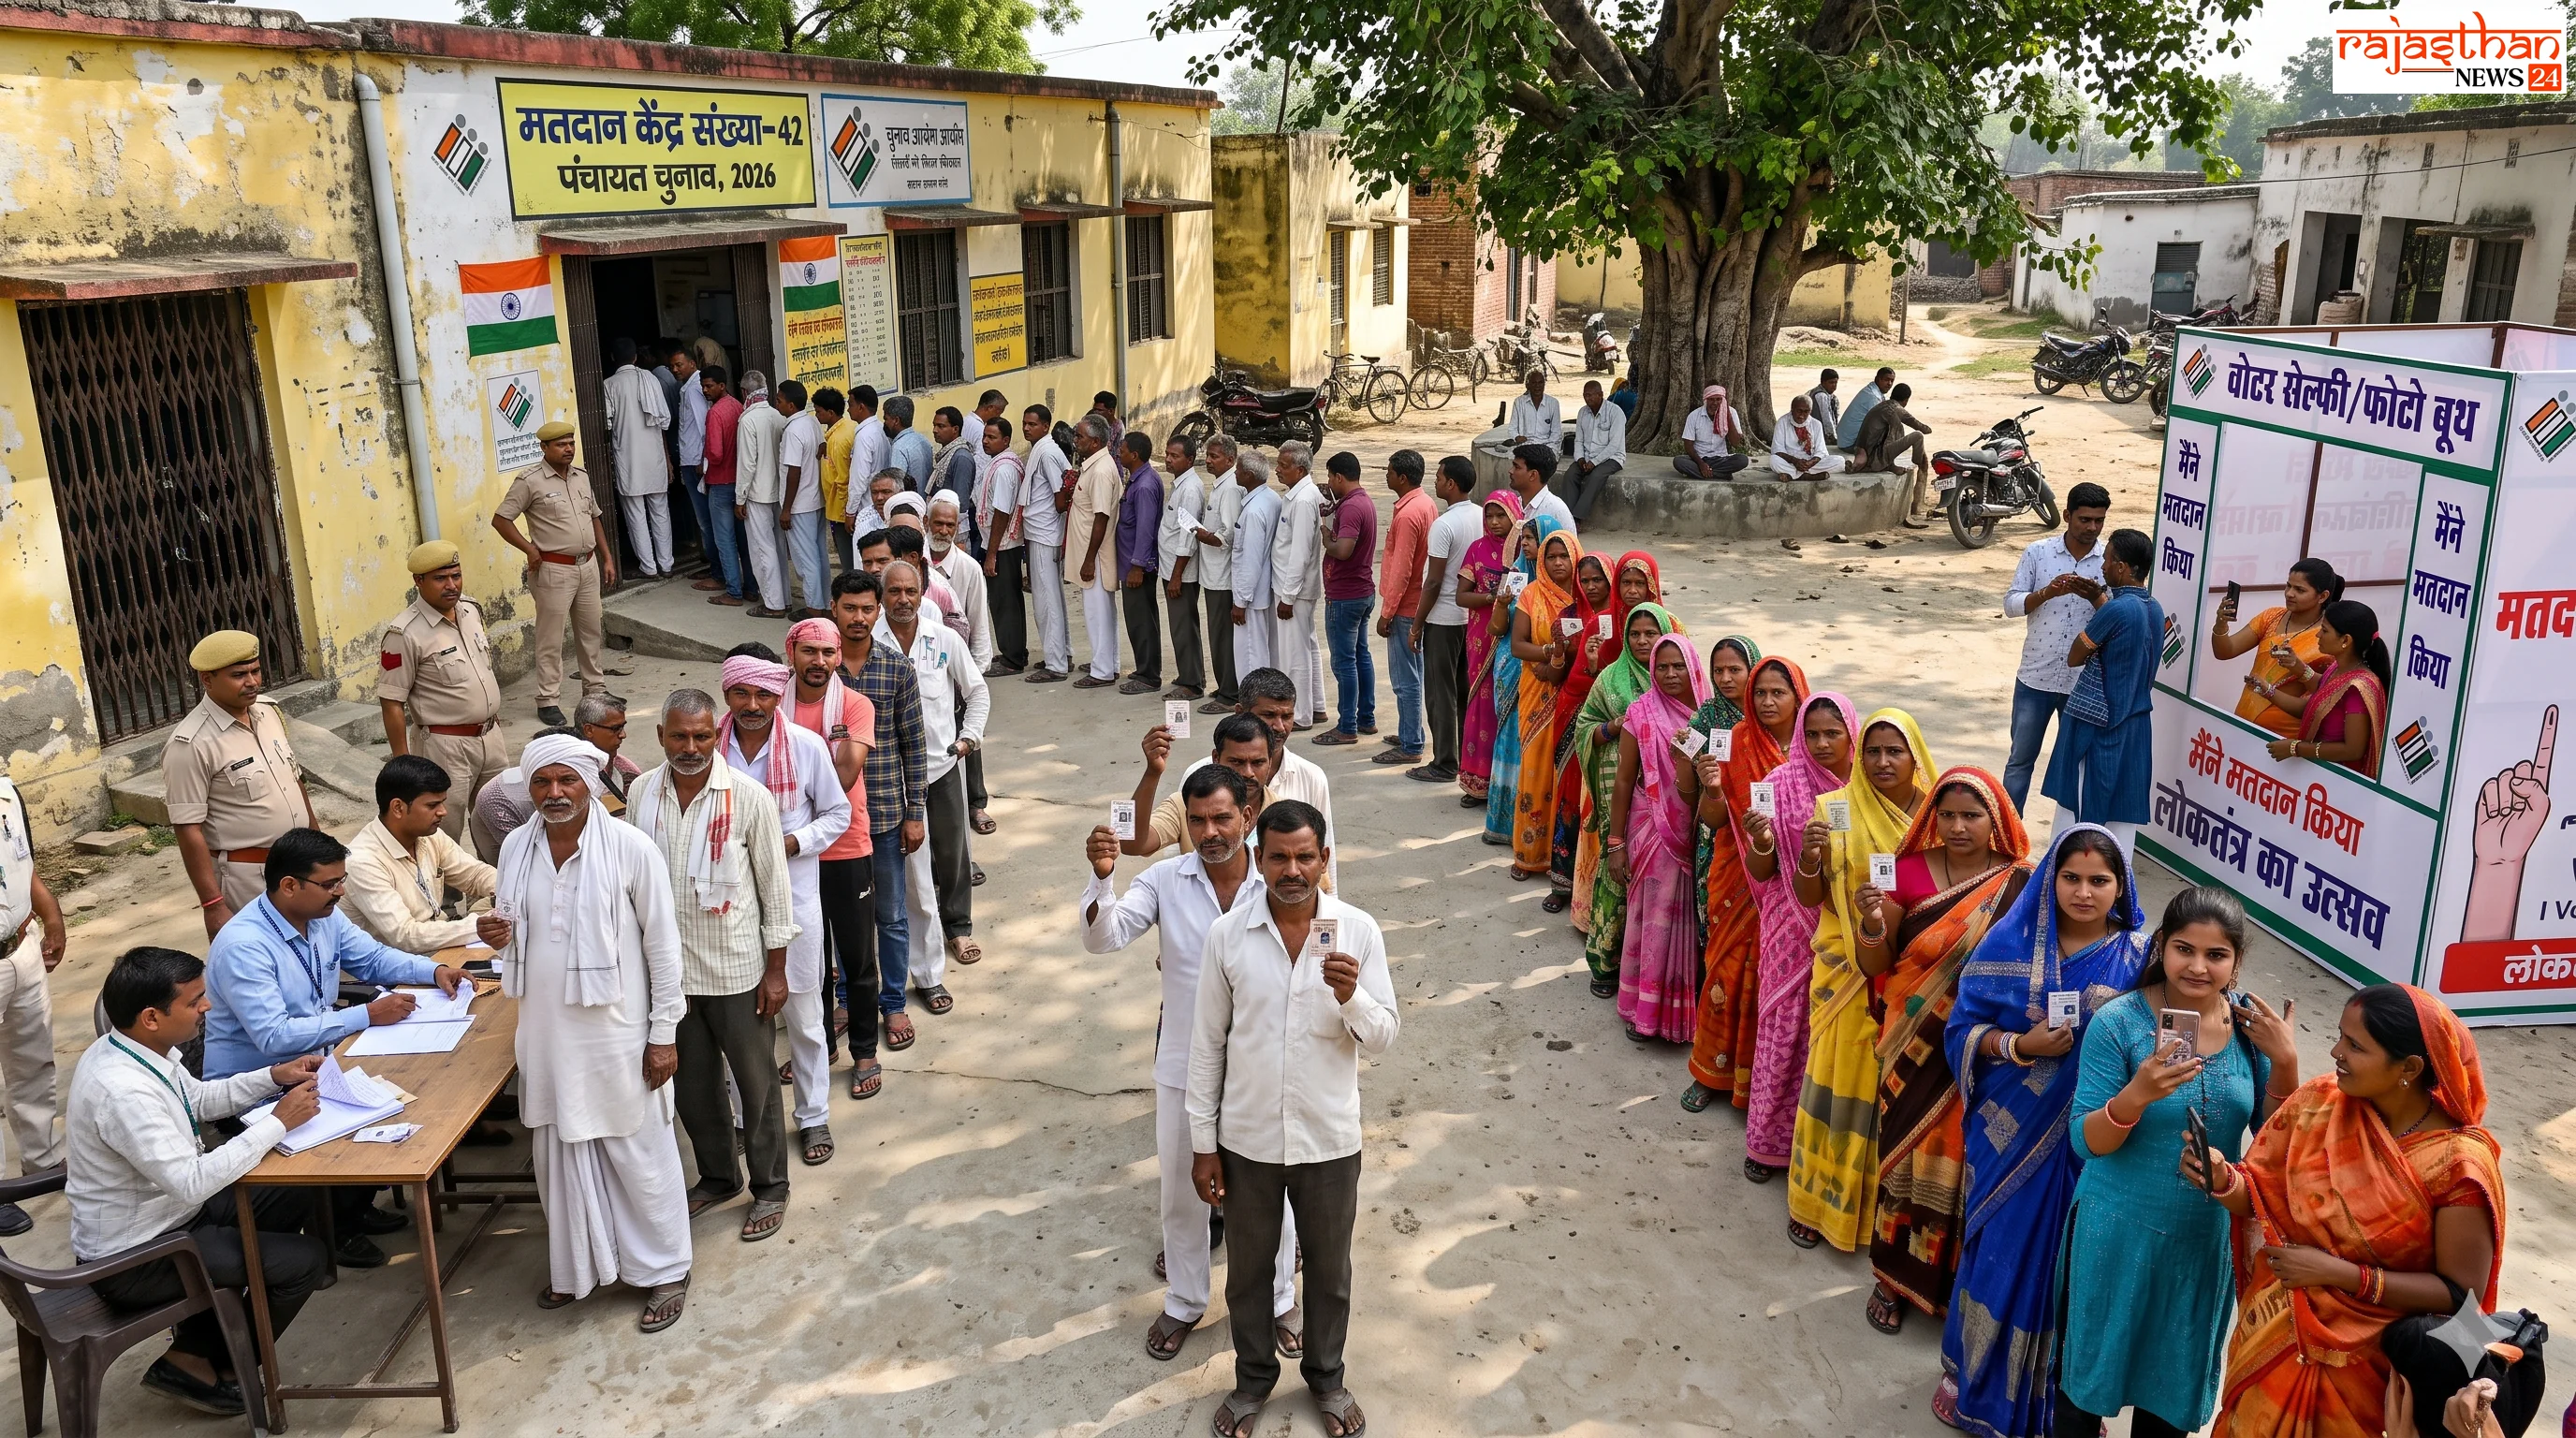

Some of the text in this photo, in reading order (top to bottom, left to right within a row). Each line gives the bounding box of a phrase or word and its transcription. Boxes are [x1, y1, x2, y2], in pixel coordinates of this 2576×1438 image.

[516, 107, 627, 144] मतदान
[634, 97, 684, 153] केंद्र
[557, 154, 777, 205] पंचायत चुनाव, 2026
[2228, 352, 2278, 405] वोटर
[2282, 360, 2428, 433] सेल्फी/फोटो
[2433, 395, 2481, 455] बूथ
[2162, 492, 2206, 532] मतदान
[2161, 536, 2195, 581] किया
[2412, 568, 2472, 620] मतदान
[2407, 634, 2452, 690] किया
[2188, 726, 2364, 857] मैंने मतदान किया
[2154, 778, 2392, 951] लोकतंत्र का उत्सव
[2503, 944, 2576, 985] लोक
